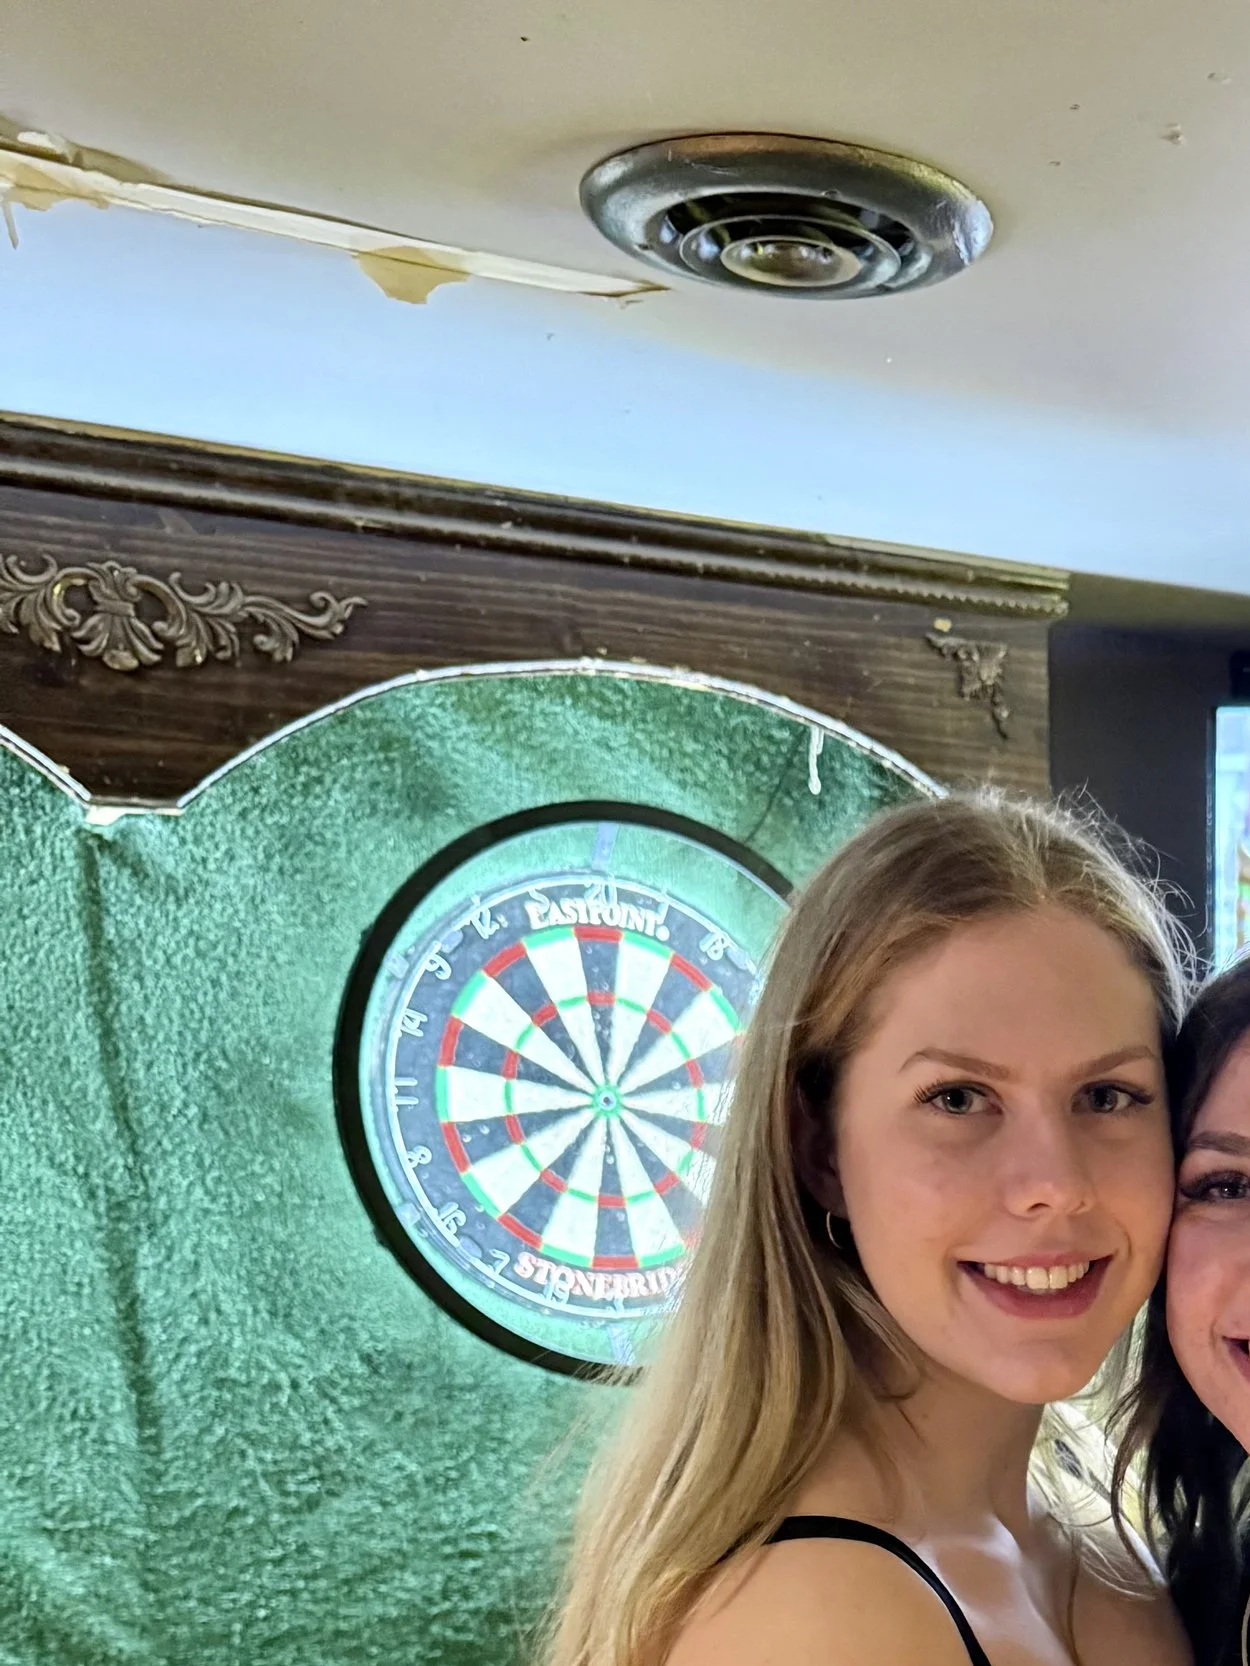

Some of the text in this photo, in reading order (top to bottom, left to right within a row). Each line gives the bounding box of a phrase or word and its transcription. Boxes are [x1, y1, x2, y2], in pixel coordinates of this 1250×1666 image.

[584, 874, 617, 908] 20
[700, 931, 728, 961] 18
[424, 952, 452, 980] 9
[401, 1008, 429, 1037] 14
[395, 1077, 420, 1105] 11
[406, 1145, 433, 1169] 8
[489, 1248, 511, 1275] 7
[513, 1251, 684, 1301] STONEBRID
